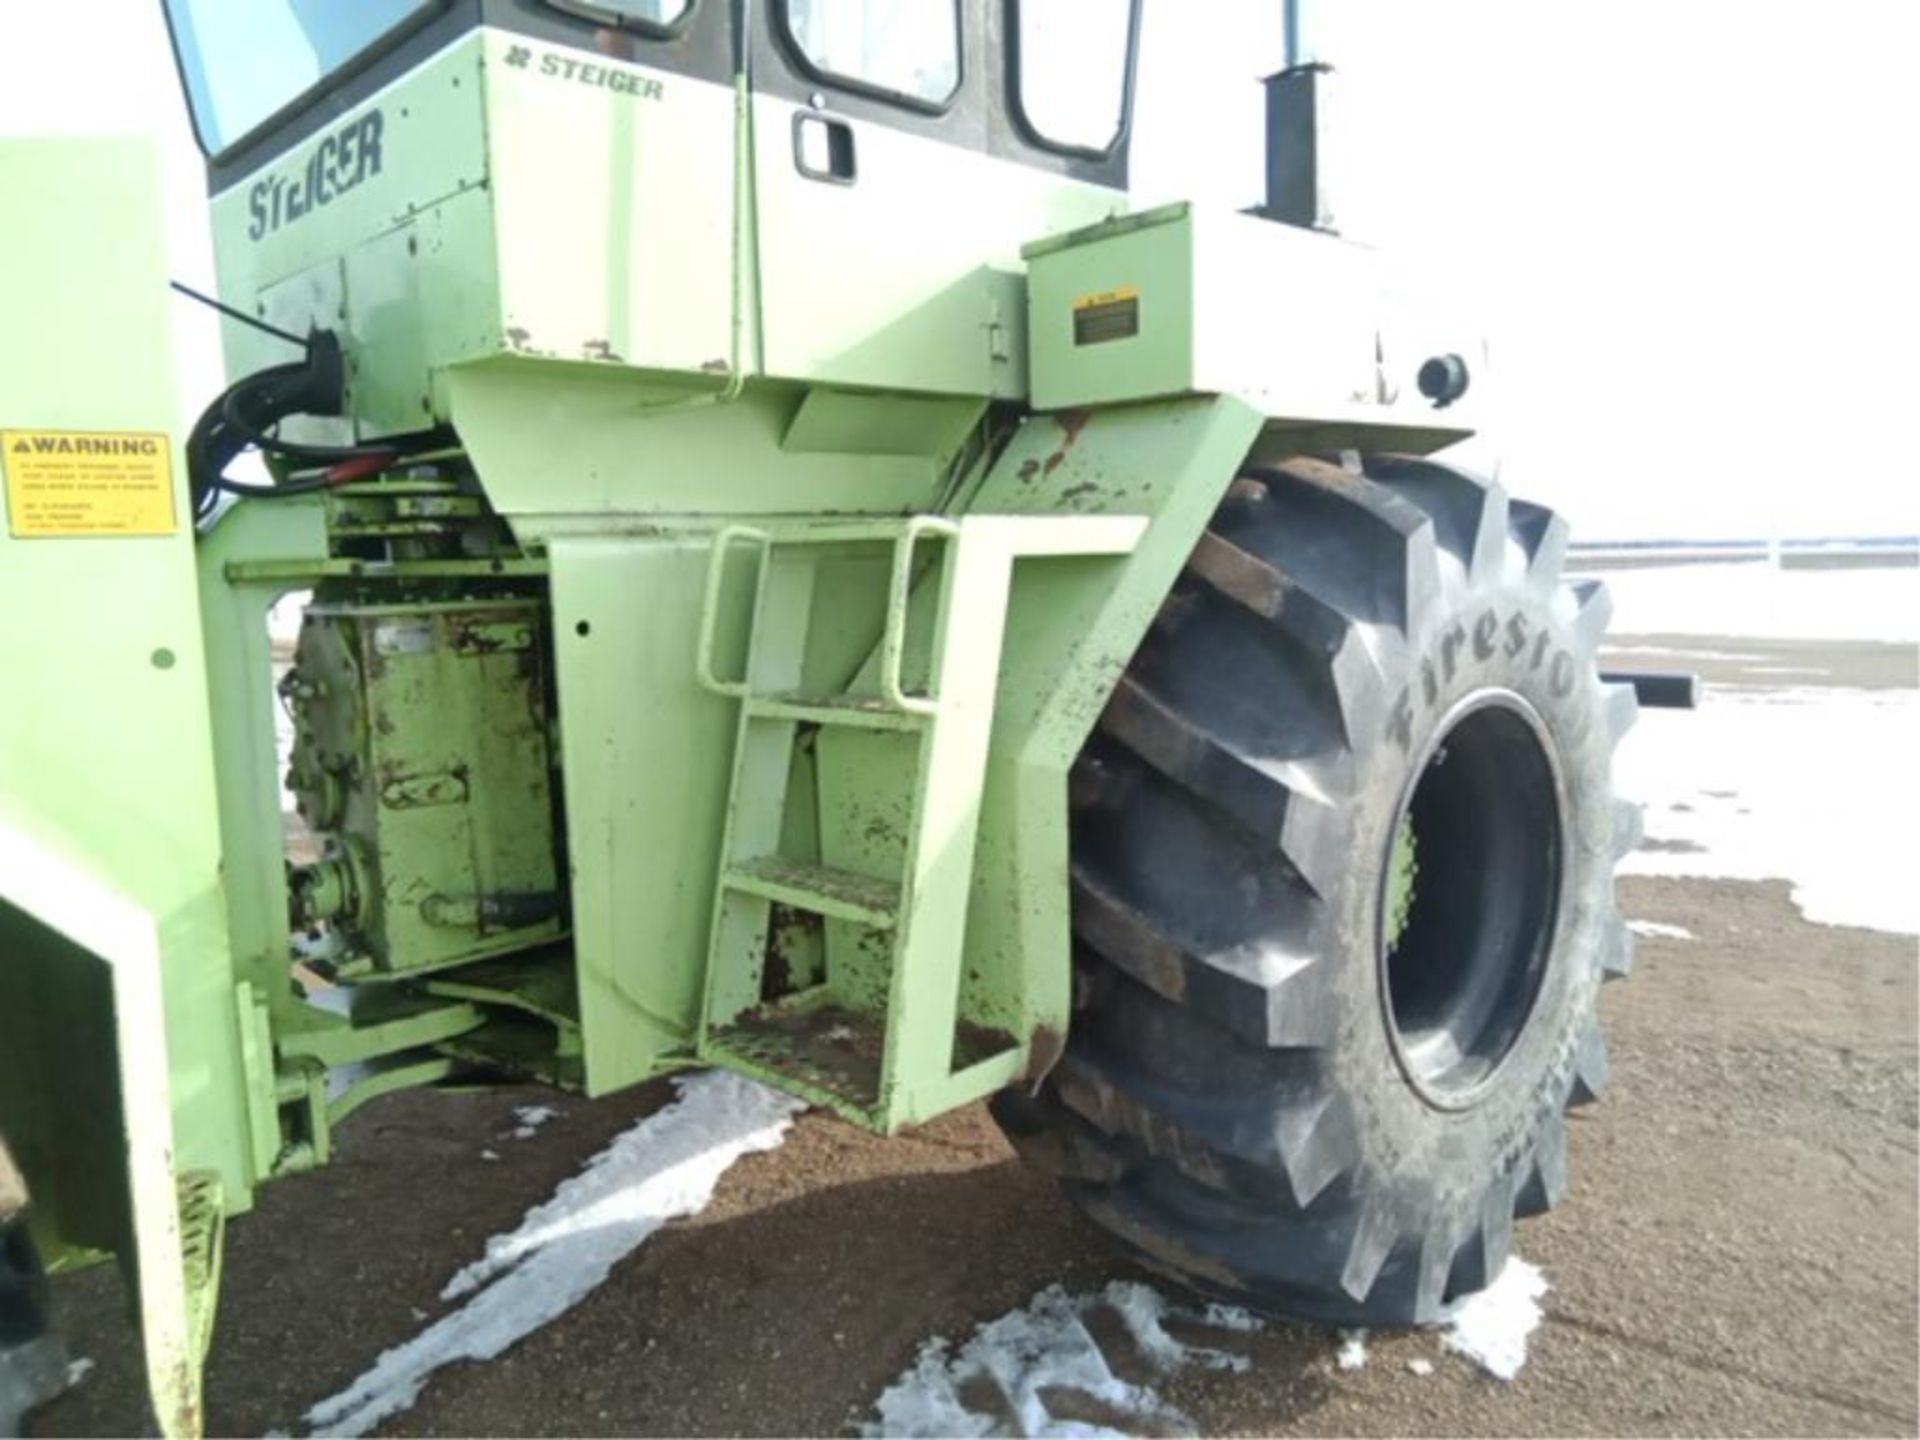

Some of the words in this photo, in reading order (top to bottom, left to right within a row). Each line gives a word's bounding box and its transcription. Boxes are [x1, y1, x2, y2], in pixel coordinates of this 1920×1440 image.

[540, 53, 664, 101] STEIGER
[249, 108, 384, 242] STEIGER
[32, 437, 158, 456] WARNING
[1384, 607, 1592, 754] Firesto
